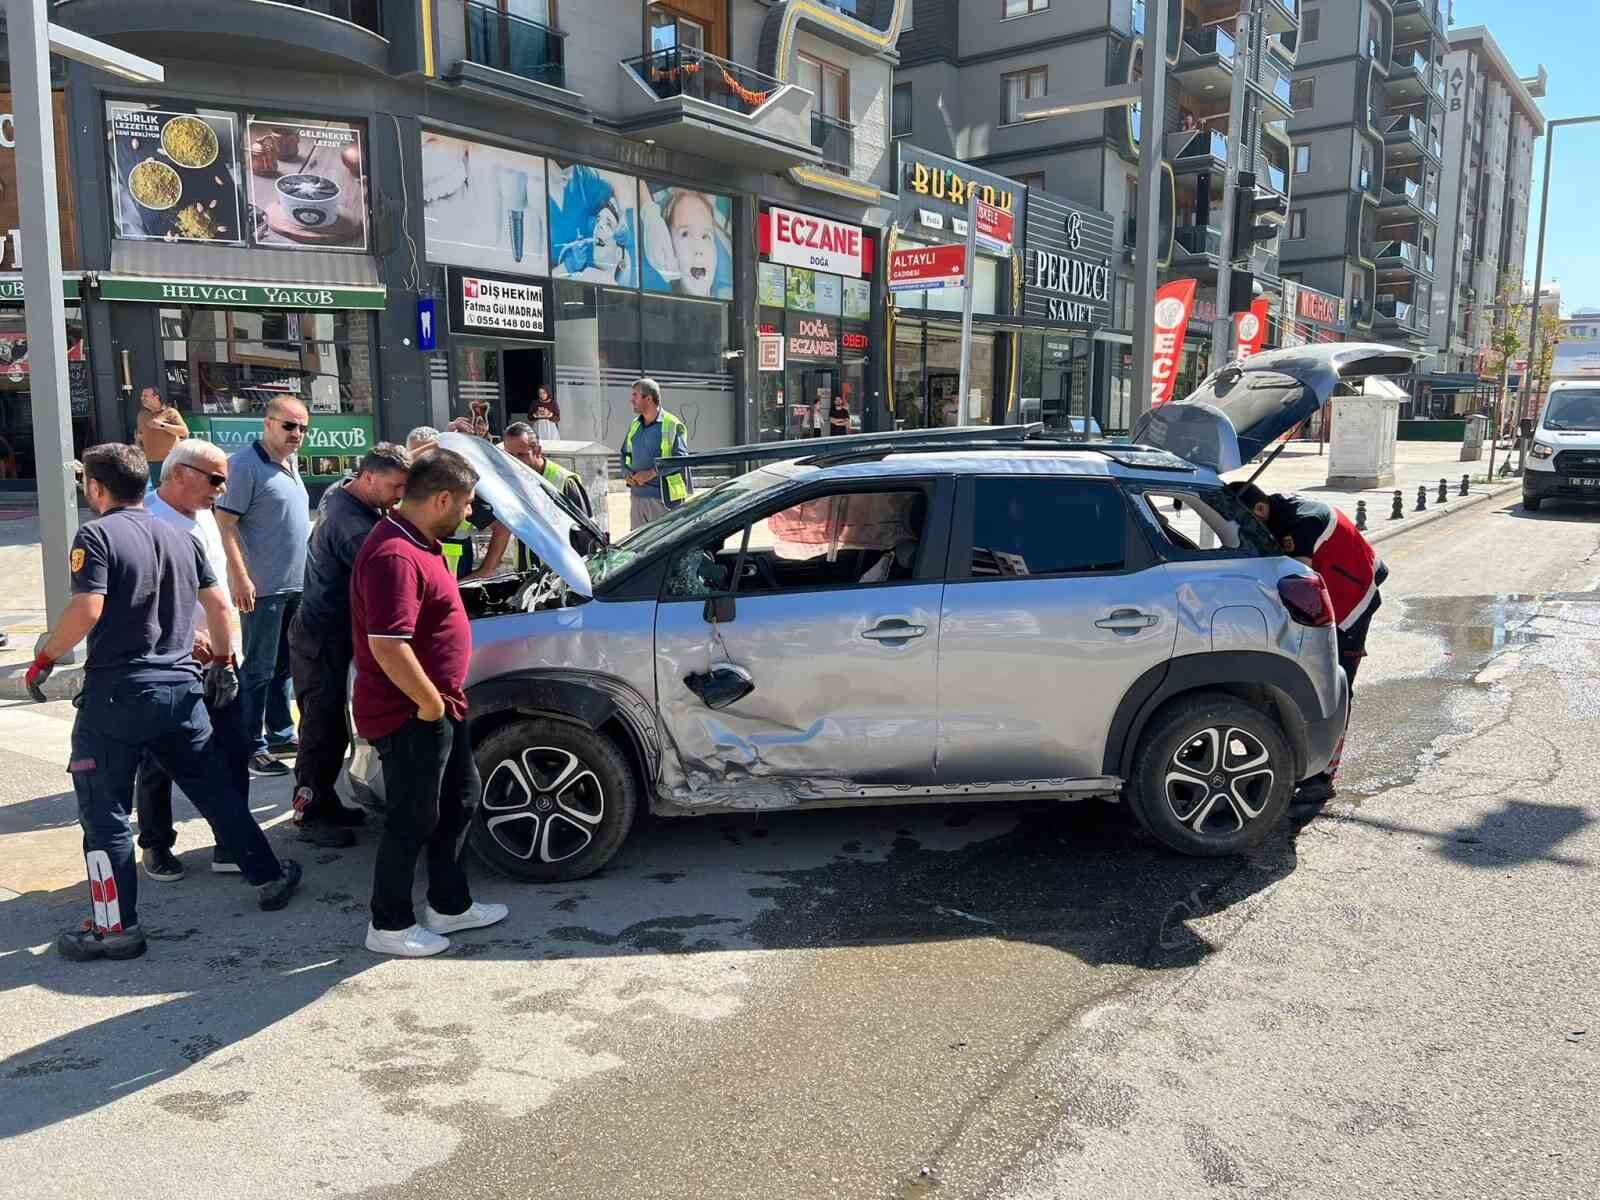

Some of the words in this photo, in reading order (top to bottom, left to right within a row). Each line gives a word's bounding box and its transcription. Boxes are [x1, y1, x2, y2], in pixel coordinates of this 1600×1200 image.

[115, 113, 159, 125] ASIRLIK
[776, 213, 860, 257] ECZANE
[810, 256, 829, 267] DOĞA
[894, 252, 936, 268] ALTAYLI
[1035, 249, 1109, 301] PERDECİ
[162, 284, 248, 301] HELVACI
[263, 287, 335, 306] YAKUB
[480, 283, 500, 299] DİŞ
[502, 287, 542, 302] HEKİMİ
[465, 300, 491, 313] Fatma
[493, 303, 507, 315] Gül
[508, 305, 542, 318] MADRAN
[1048, 298, 1095, 322] SAMET
[1301, 291, 1335, 323] MIGROS
[477, 315, 500, 326] 0554
[502, 318, 518, 328] 148
[520, 320, 531, 329] 00
[800, 319, 829, 338] DOĞA
[307, 427, 366, 449] YAKUB
